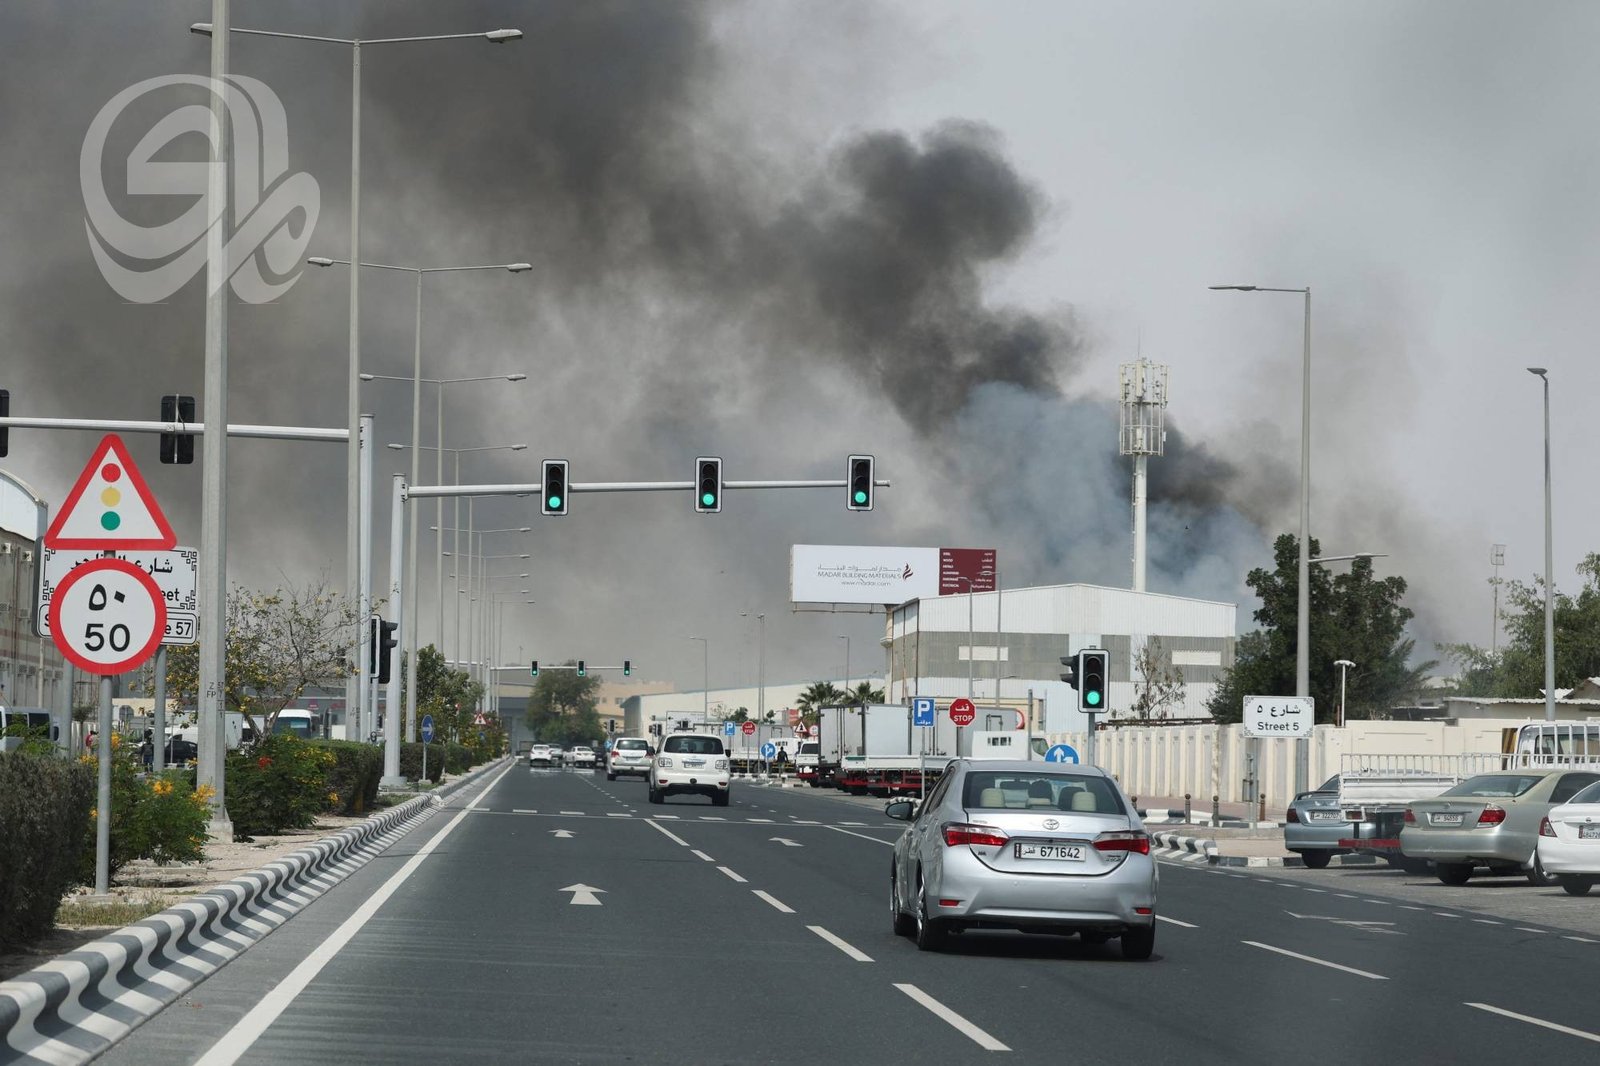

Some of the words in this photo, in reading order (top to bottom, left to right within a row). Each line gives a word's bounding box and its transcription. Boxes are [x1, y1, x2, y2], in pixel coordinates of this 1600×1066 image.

[89, 584, 125, 611] ٥٠
[176, 622, 191, 635] 57
[85, 624, 130, 651] 50
[206, 690, 216, 698] FP
[918, 700, 930, 717] P
[1270, 704, 1301, 717] شارع
[1257, 721, 1290, 731] Street
[1292, 722, 1300, 731] 5
[1040, 846, 1081, 859] 671642
